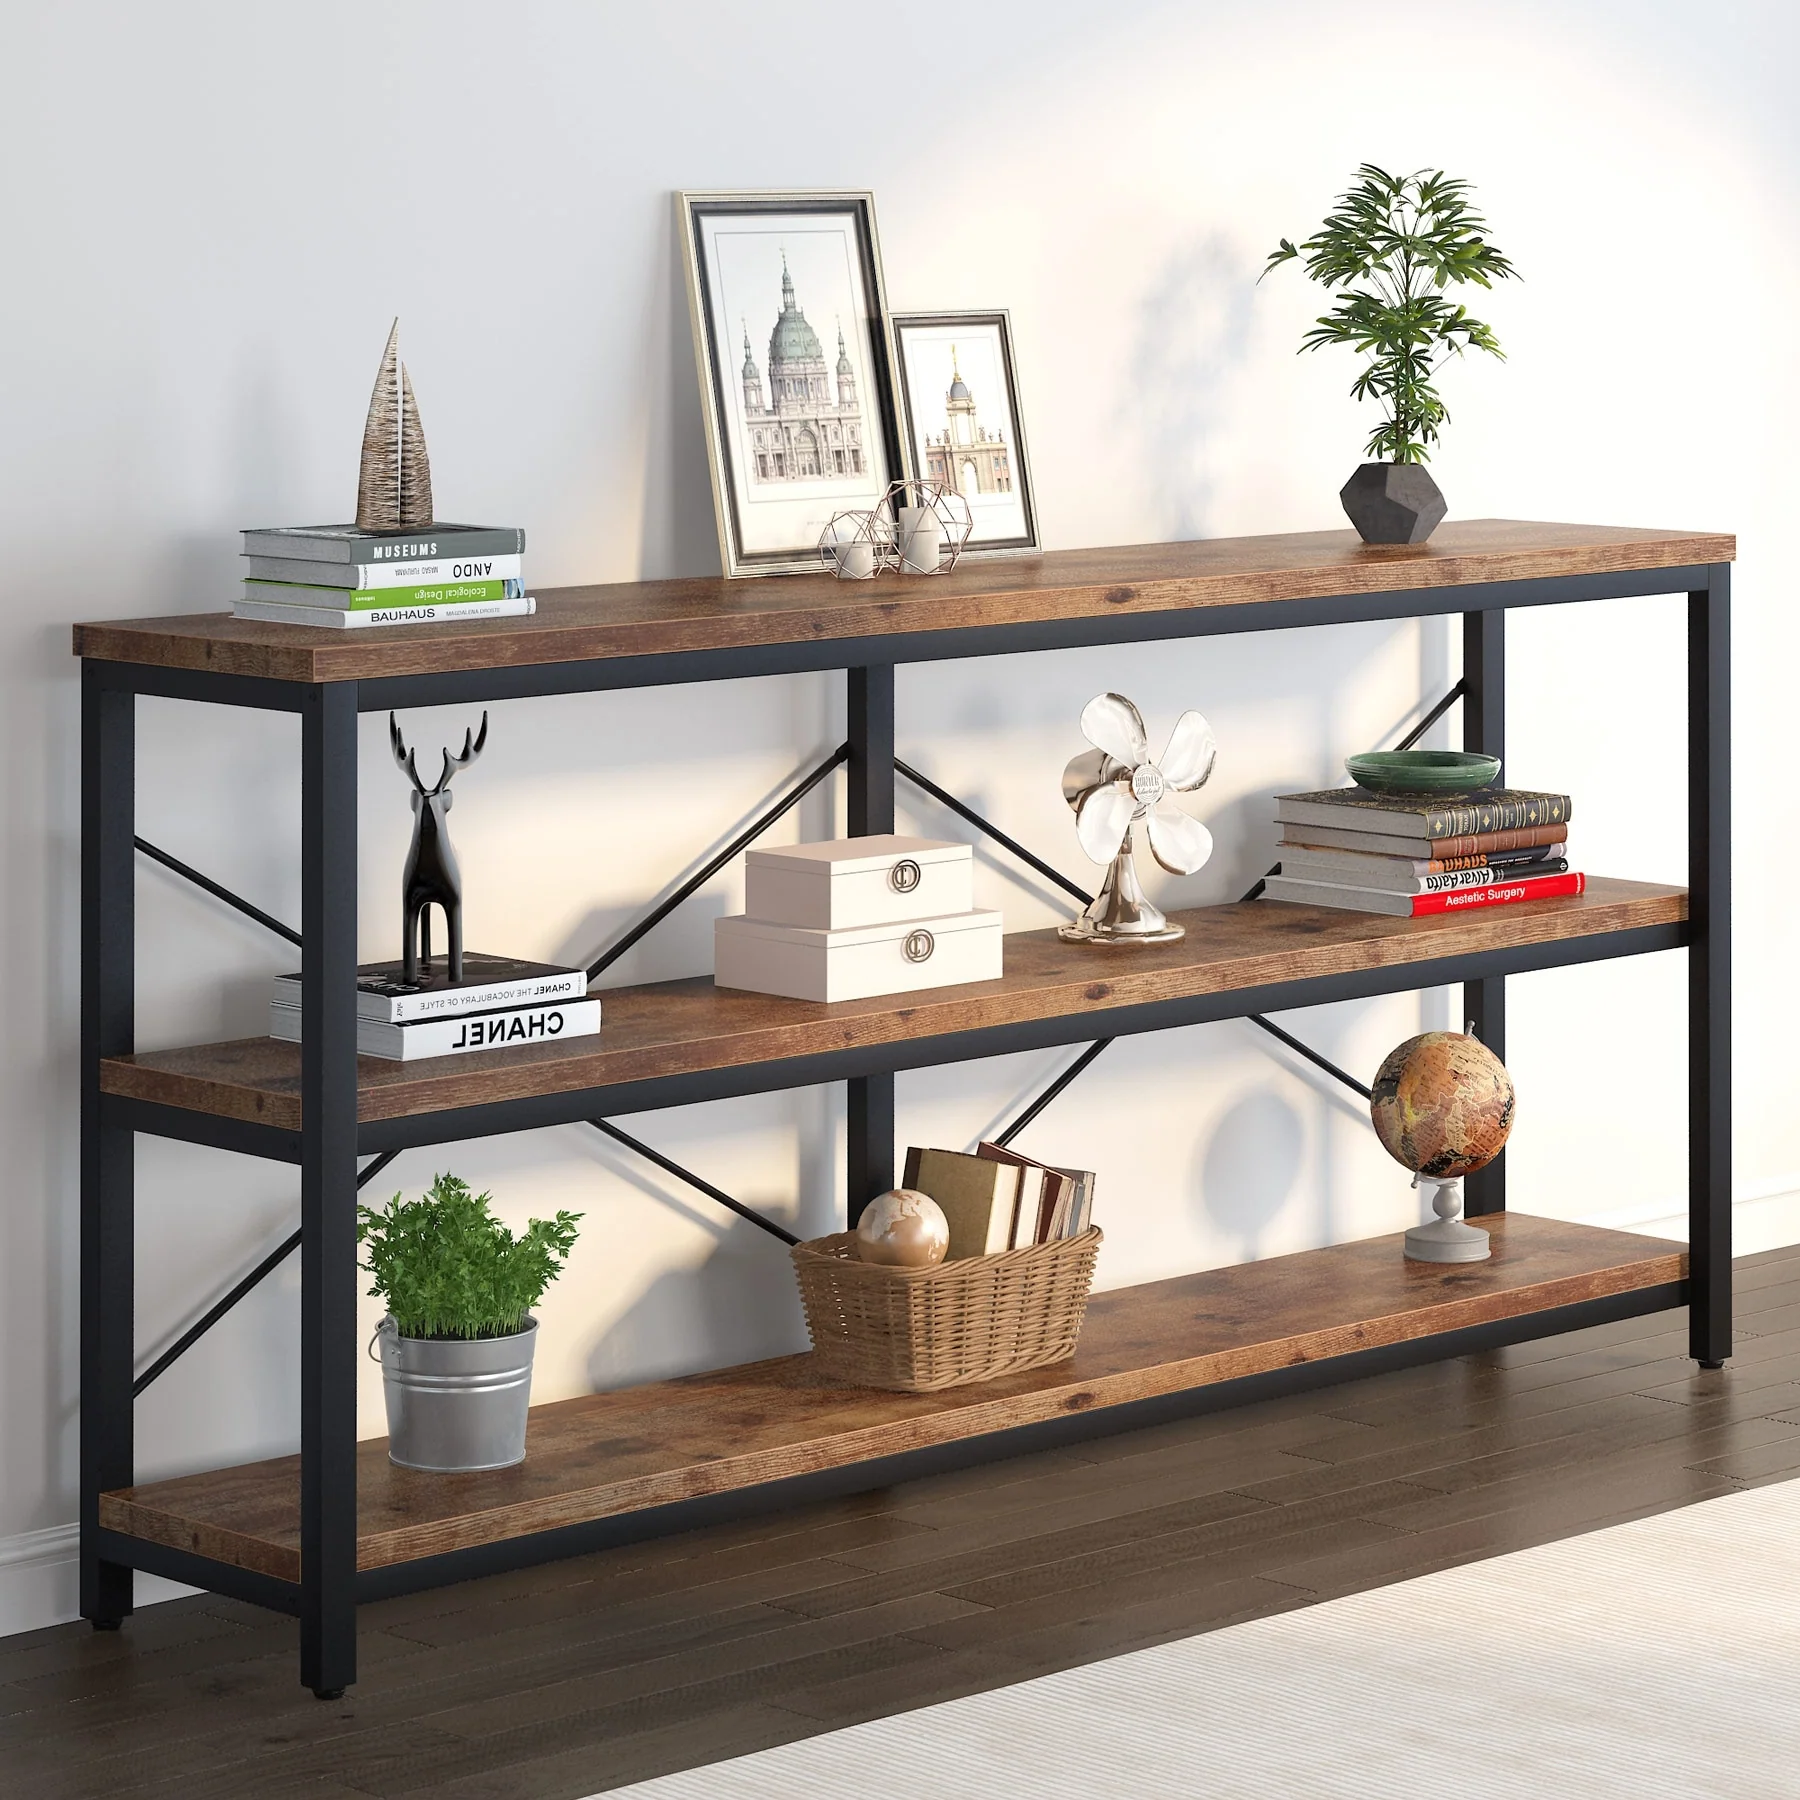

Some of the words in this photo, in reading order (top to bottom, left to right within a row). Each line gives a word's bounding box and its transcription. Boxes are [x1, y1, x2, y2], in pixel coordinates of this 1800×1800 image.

[374, 543, 437, 559] MUSEUMS
[453, 562, 492, 578] ANDO
[414, 590, 443, 602] Design
[445, 586, 487, 600] Ecological
[371, 609, 435, 622] BAUHAUS
[1428, 854, 1488, 873] BAUHAUS
[1445, 889, 1484, 907] Aestetic
[1487, 886, 1526, 903] Surgery
